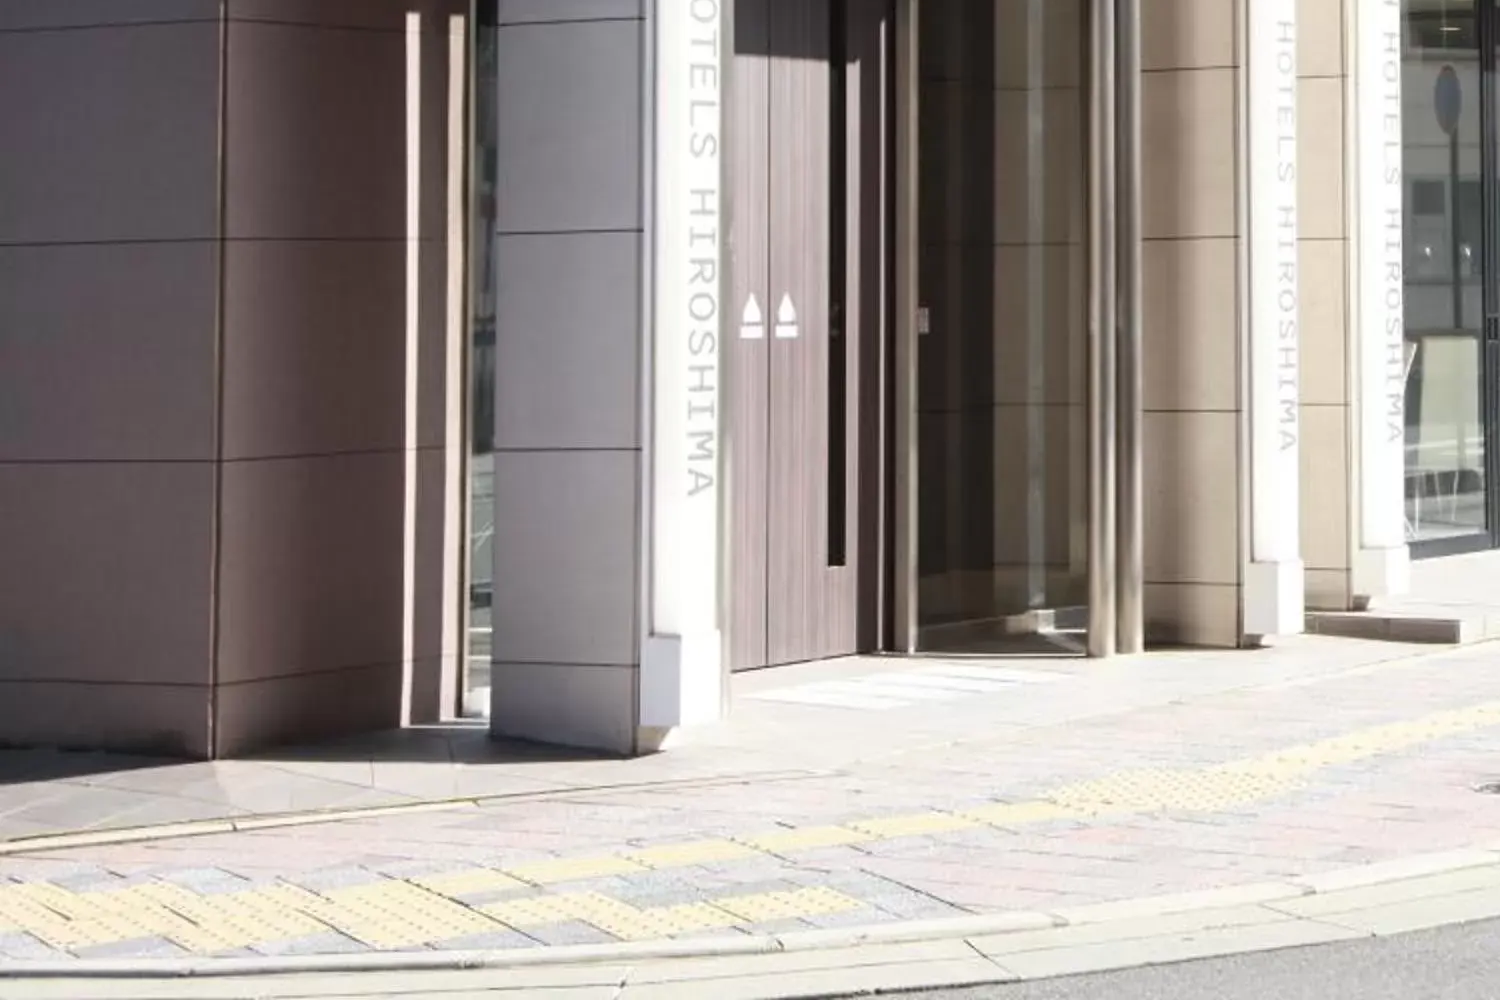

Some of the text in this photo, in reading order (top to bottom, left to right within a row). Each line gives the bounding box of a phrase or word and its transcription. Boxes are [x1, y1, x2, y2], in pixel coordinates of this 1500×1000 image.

[1276, 20, 1296, 183] HOTELS
[1382, 31, 1401, 186] HOTELS
[686, 188, 717, 498] HIROSHIMA
[1277, 205, 1297, 452] HIROSHIMA
[1384, 207, 1403, 443] HIROSHIMA
